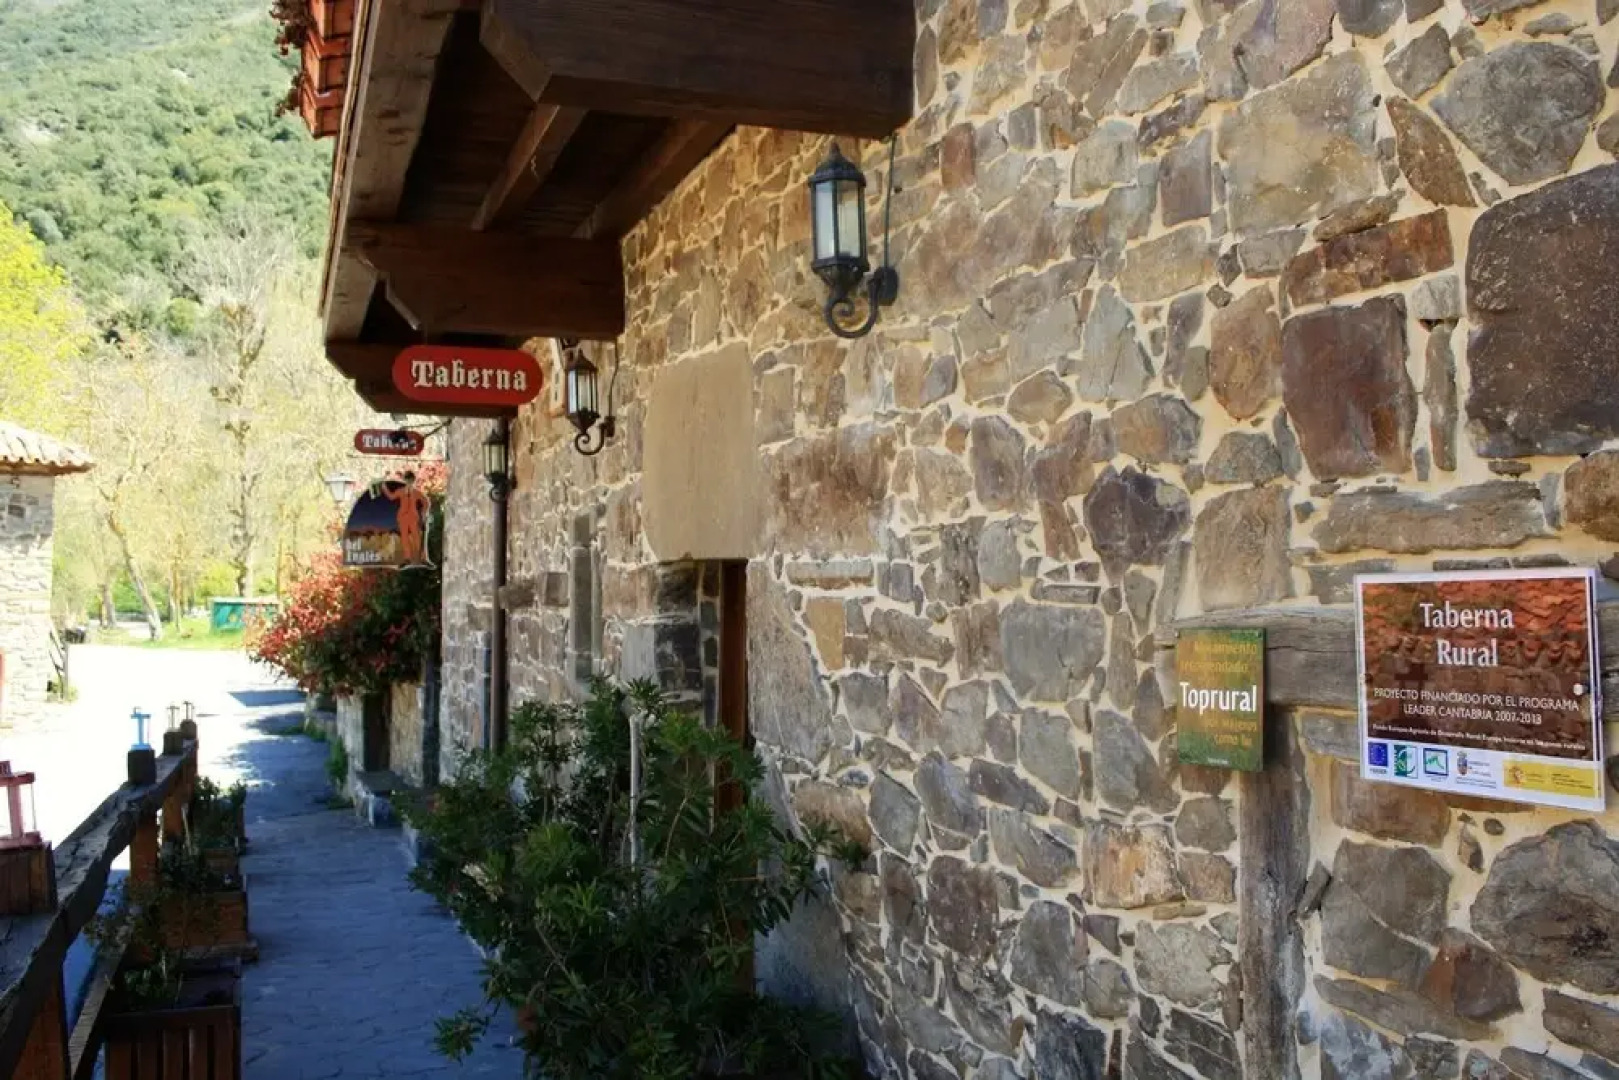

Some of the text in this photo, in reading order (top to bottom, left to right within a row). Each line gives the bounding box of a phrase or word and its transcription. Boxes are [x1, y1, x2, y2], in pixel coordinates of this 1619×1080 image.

[411, 359, 527, 392] Taberna
[1419, 600, 1515, 629] Taberna
[1437, 638, 1498, 668] Rural
[1180, 682, 1257, 715] Toprural
[1373, 687, 1580, 711] PROYECTO FINANCIADO POR EL PROGRAMA
[1403, 703, 1542, 725] LEADER CANTABRIA 2007-2013
